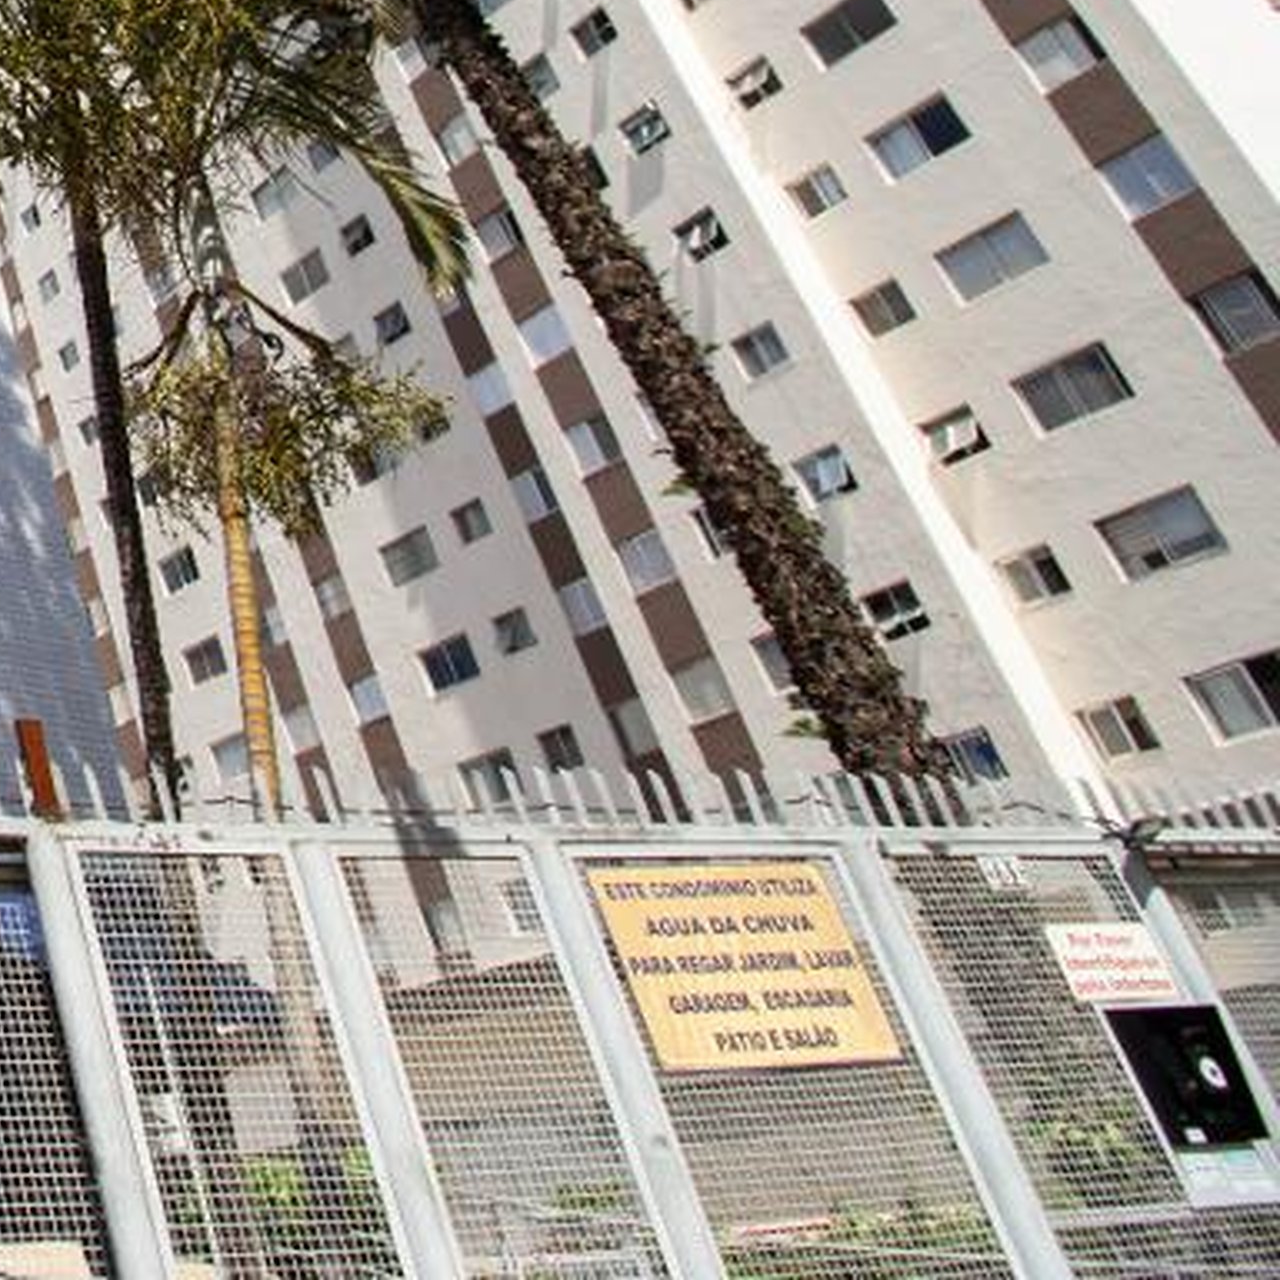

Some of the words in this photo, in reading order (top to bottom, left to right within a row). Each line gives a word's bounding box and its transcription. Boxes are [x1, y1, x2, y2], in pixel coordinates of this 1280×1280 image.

[602, 882, 646, 901] ESTE
[759, 877, 817, 898] UTILIZA
[708, 916, 740, 935] DA
[742, 914, 815, 934] CHUVA
[627, 955, 676, 976] PARA
[677, 953, 735, 974] REGAR
[762, 988, 854, 1010] ESCADARIA
[766, 1028, 784, 1051] E
